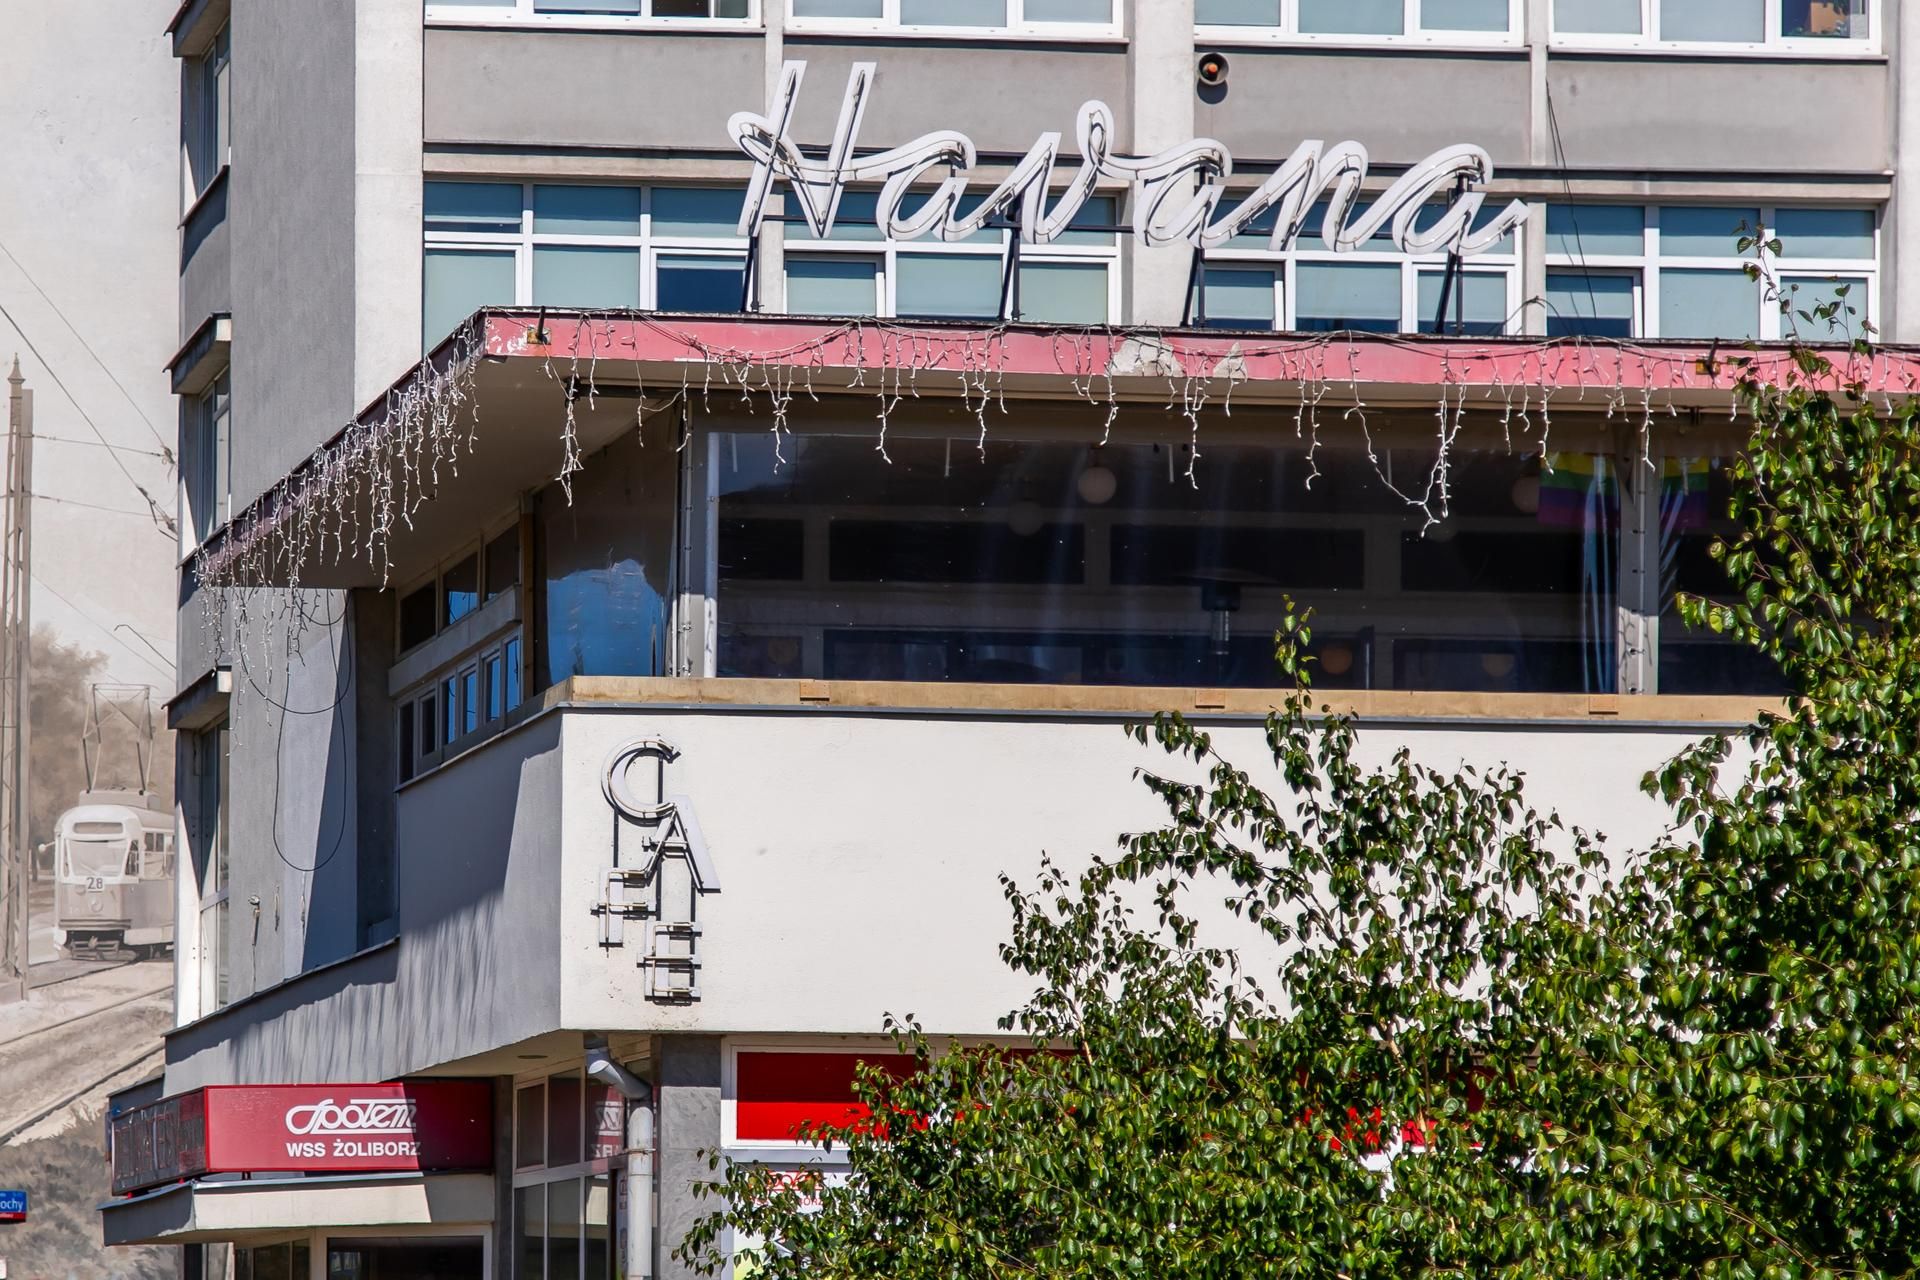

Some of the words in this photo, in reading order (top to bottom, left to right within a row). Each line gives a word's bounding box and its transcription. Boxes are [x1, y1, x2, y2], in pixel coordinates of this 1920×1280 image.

[727, 59, 1529, 256] Havana
[590, 735, 721, 1004] CAFE
[86, 876, 104, 890] 28
[286, 1142, 326, 1157] WSS
[333, 1138, 421, 1157] ŻOLIBORZ
[0, 1198, 24, 1213] ochy
